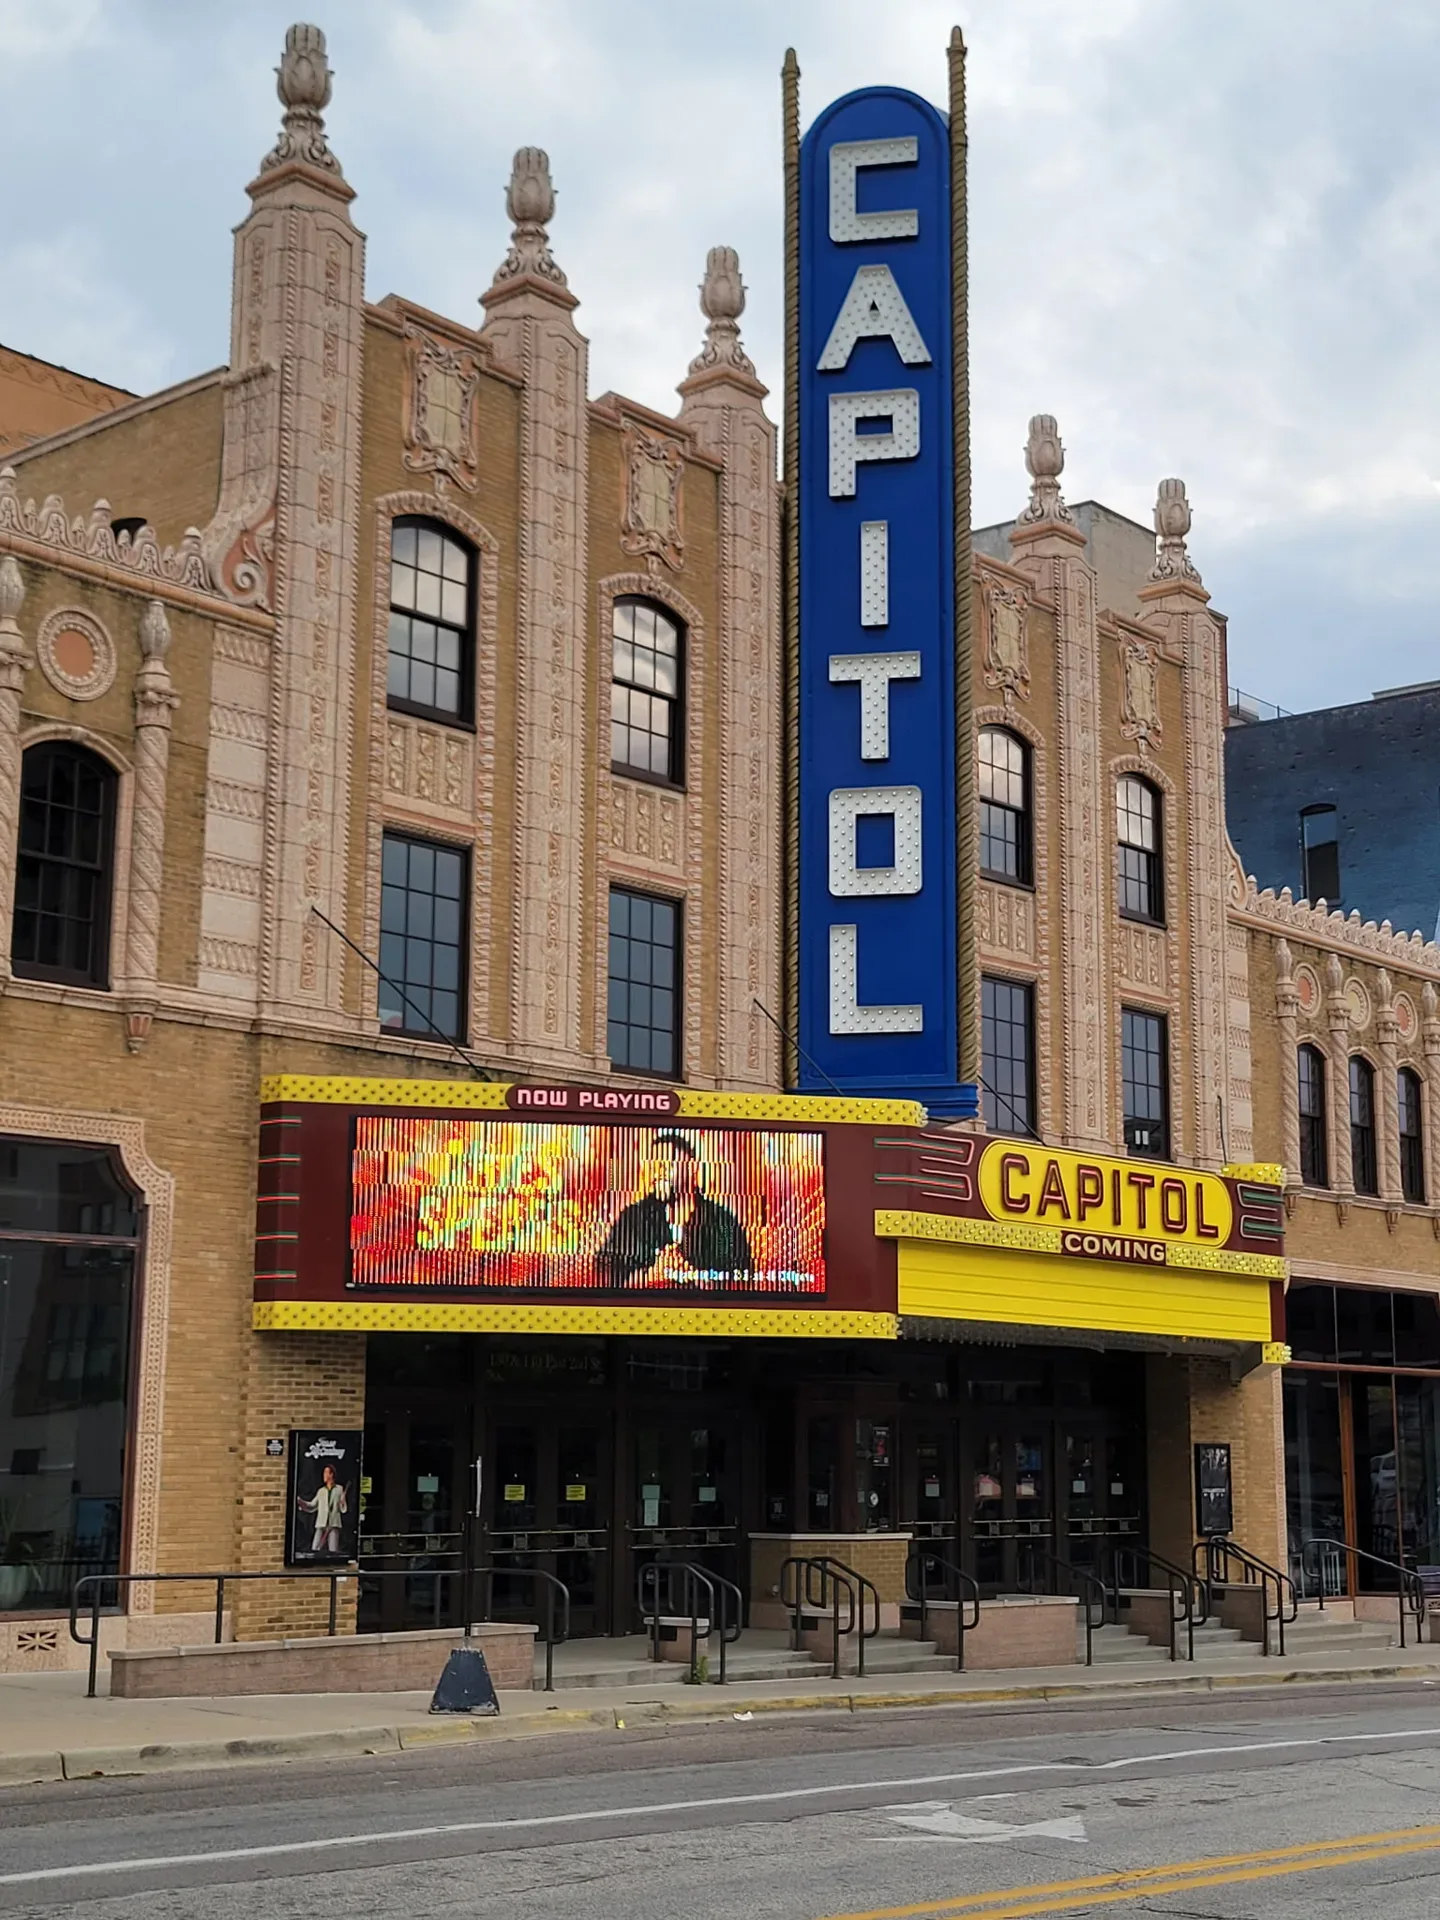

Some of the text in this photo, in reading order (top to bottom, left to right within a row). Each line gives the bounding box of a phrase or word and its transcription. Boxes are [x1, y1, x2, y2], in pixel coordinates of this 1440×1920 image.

[816, 136, 932, 1034] CAPITOL
[517, 1089, 671, 1111] NOW PLAYING
[1000, 1152, 1220, 1239] CAPITOL
[1064, 1233, 1165, 1262] COMING
